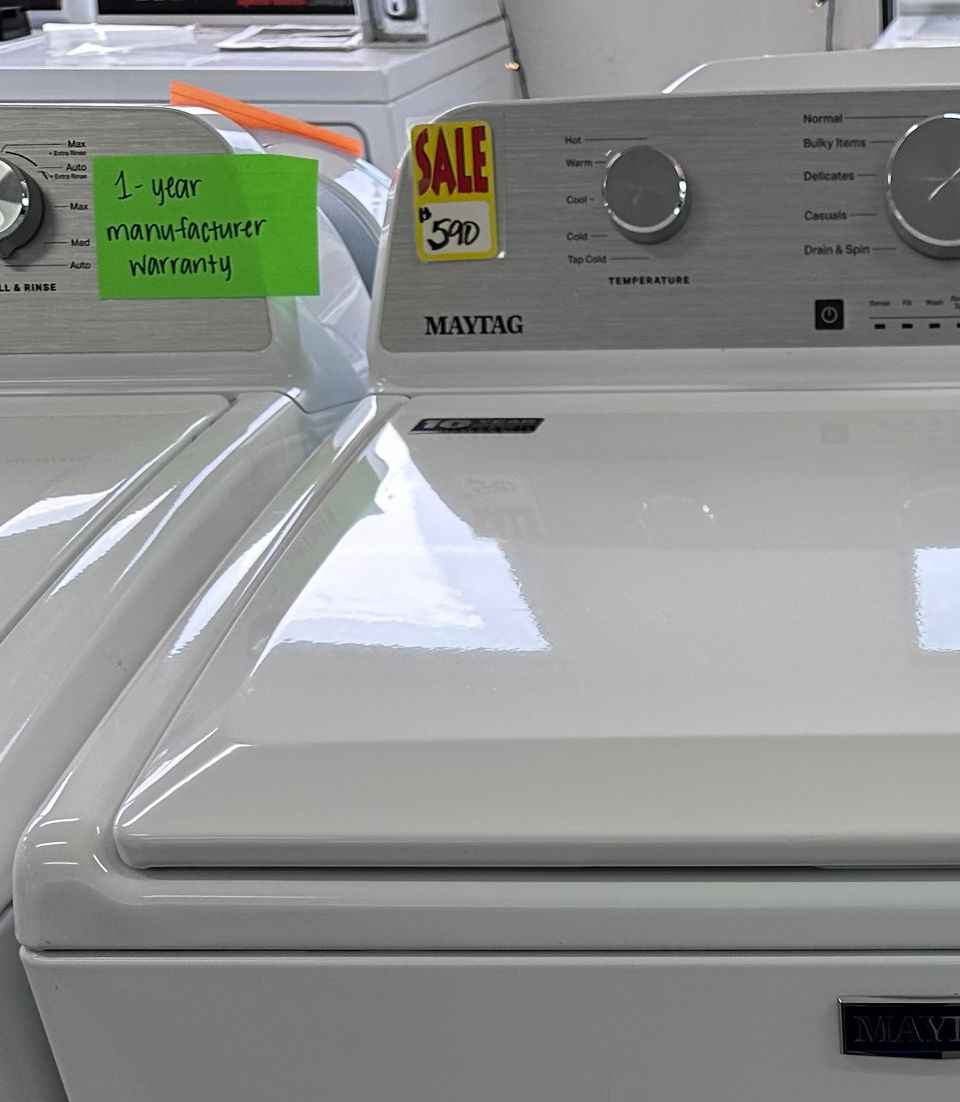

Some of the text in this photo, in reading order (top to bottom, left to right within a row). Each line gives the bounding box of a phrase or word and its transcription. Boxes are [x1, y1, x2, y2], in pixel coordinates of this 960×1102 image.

[803, 113, 843, 124] Normal
[67, 140, 87, 148] Max
[565, 135, 582, 146] Hot
[803, 137, 866, 150] Bulky Items
[415, 125, 489, 196] SALE
[566, 158, 593, 168] Warm
[66, 164, 87, 172] Auto
[803, 171, 855, 182] Delicates
[566, 195, 588, 205] Cool
[70, 203, 89, 211] Max
[804, 210, 847, 221] Casuals
[107, 215, 268, 245] manufacturer
[566, 232, 588, 242] Cold
[71, 239, 90, 247] Med
[804, 244, 870, 257] Drain & Spin
[69, 261, 91, 270] Auto
[568, 254, 607, 266] Tap Cold
[129, 252, 233, 282] warranty
[608, 276, 690, 286] TEMPERATURE
[13, 284, 21, 292] &
[24, 283, 57, 292] RINSE
[424, 315, 524, 336] MAYTAG
